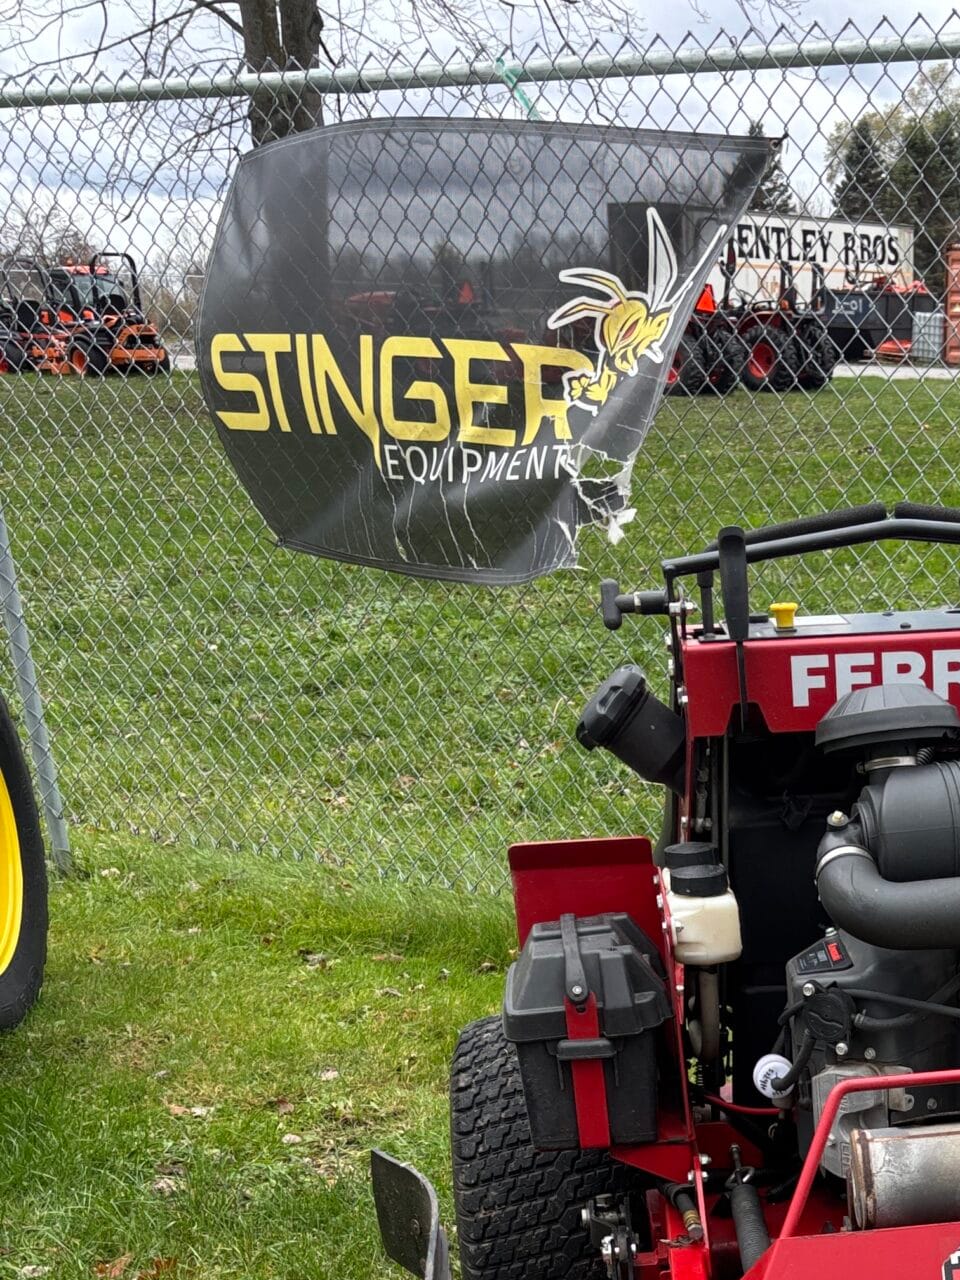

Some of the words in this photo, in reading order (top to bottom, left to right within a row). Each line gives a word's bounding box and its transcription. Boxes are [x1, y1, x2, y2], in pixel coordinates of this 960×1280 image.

[720, 223, 832, 264] ENTLEY
[210, 332, 593, 471] STINGER
[383, 444, 573, 485] EQUIPMENT
